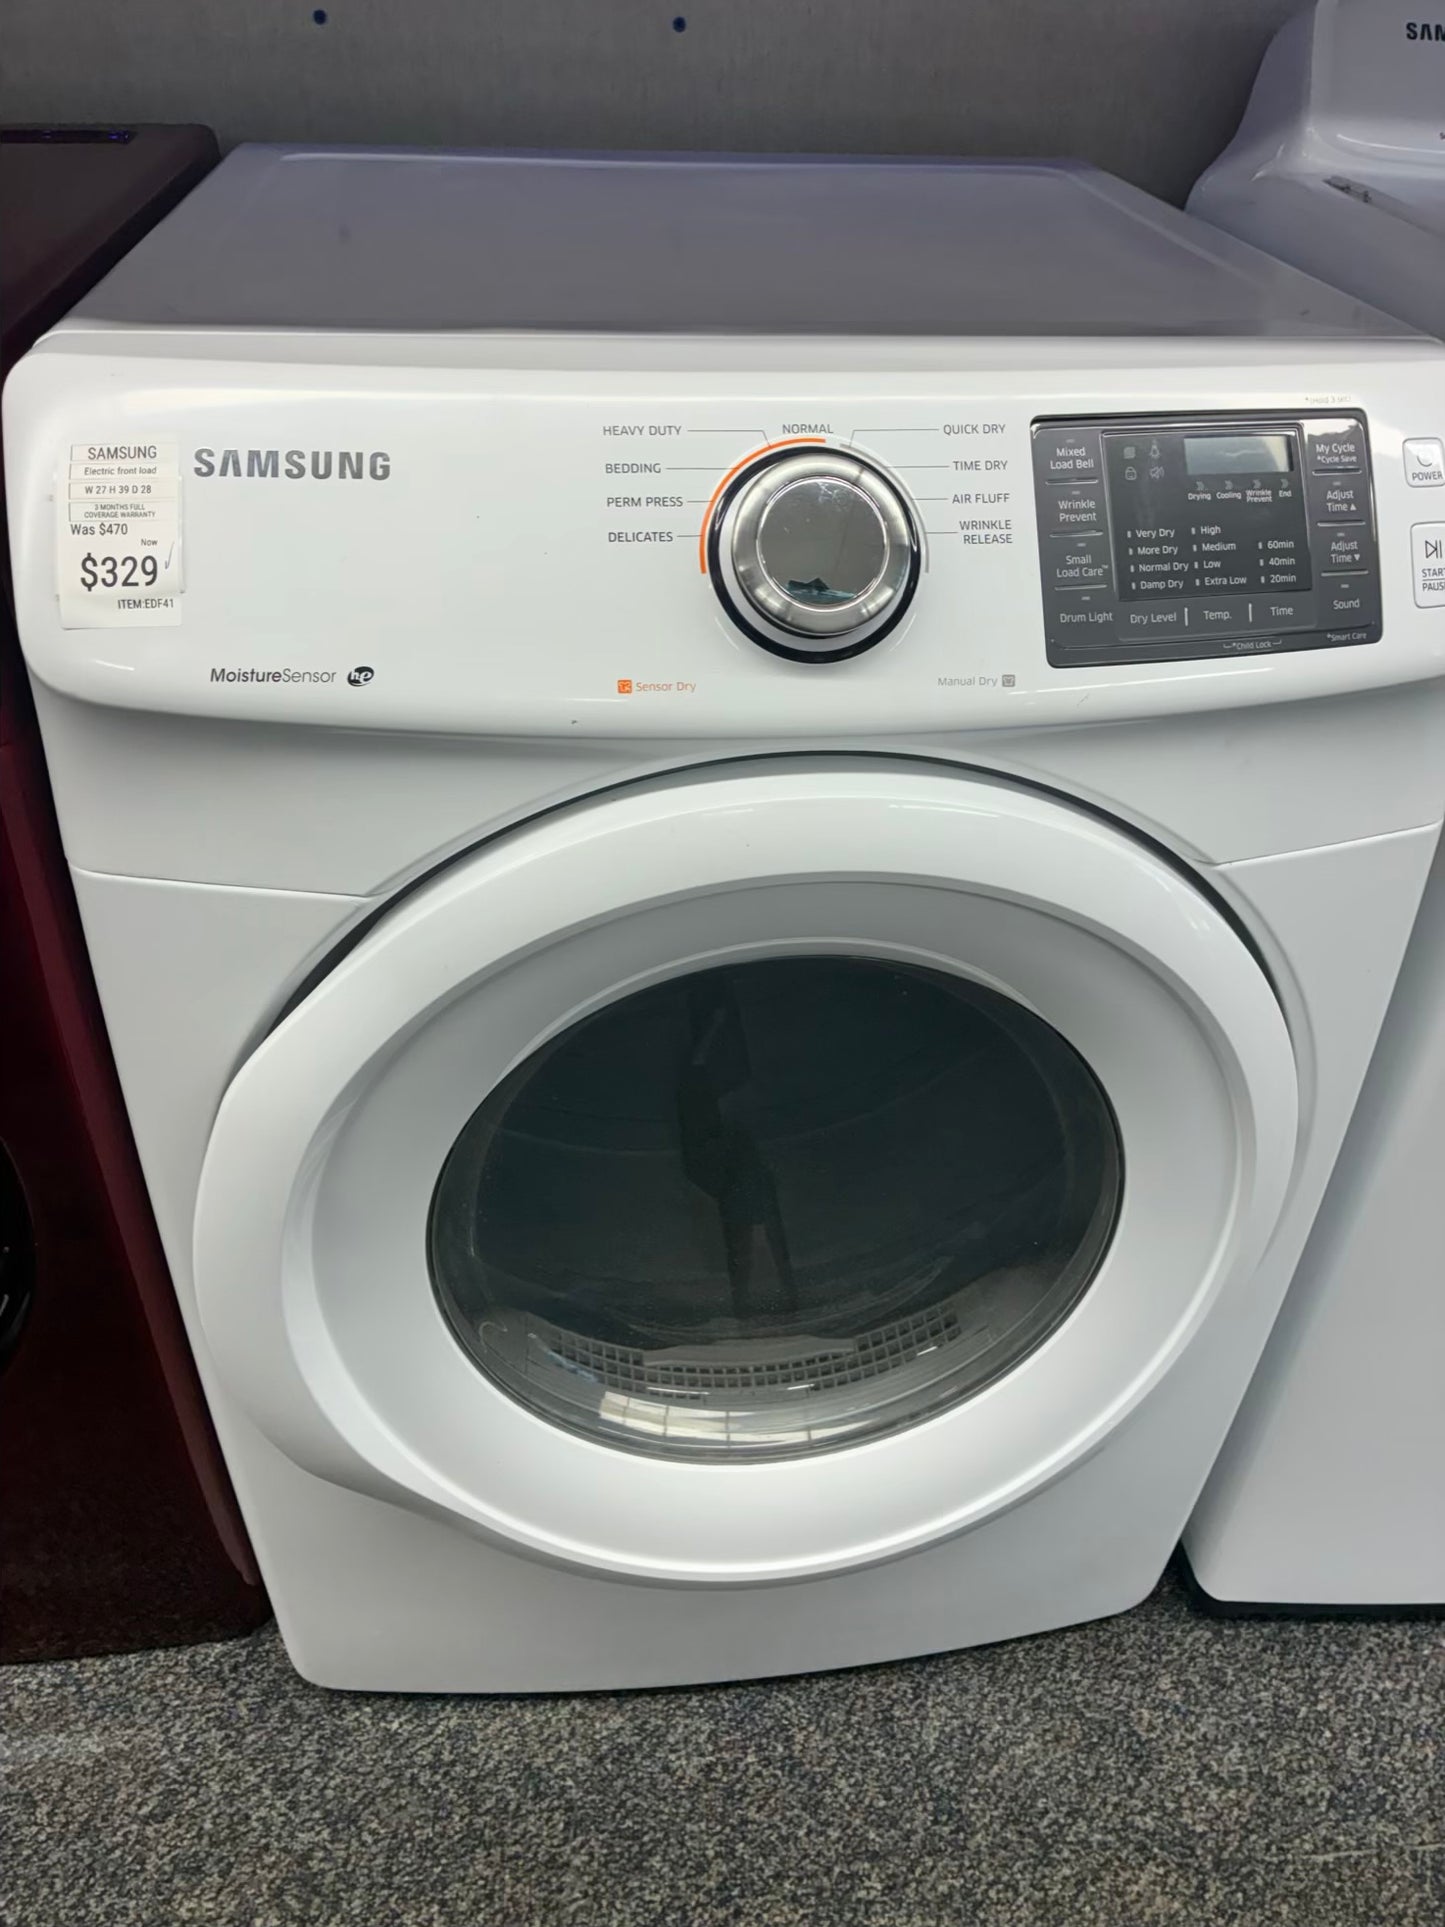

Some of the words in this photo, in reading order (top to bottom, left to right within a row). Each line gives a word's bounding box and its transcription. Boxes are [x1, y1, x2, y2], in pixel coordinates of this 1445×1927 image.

[603, 425, 644, 436] HEAVY
[649, 425, 682, 436] DUTY
[782, 424, 834, 434] NORMAL
[943, 424, 979, 435] QUICK
[983, 424, 1006, 434] DRY
[87, 446, 157, 460] SAMSUNG
[1056, 447, 1086, 456] Mixed
[1315, 444, 1329, 454] My
[1332, 443, 1355, 454] Cycle
[1340, 454, 1357, 463] Save
[194, 448, 390, 480] SAMSUNG
[605, 463, 662, 474] BEDDING
[953, 461, 981, 471] TIME
[985, 461, 1008, 471] DRY
[1050, 459, 1073, 470] Load
[1076, 458, 1094, 469] Bell
[84, 467, 114, 476] Electric
[117, 467, 136, 475] front
[139, 467, 157, 475] load
[1412, 471, 1443, 481] POWER
[85, 486, 93, 494] W
[96, 486, 106, 494] 27
[109, 486, 116, 494] H
[118, 486, 129, 494] 39
[132, 486, 138, 494] D
[141, 485, 151, 494] 28
[1246, 489, 1272, 497] Wrinkle
[952, 494, 971, 504] AIR
[975, 493, 1010, 504] FLUFF
[1188, 492, 1211, 501] Drying
[1216, 491, 1241, 500] Cooling
[1326, 490, 1354, 501] Adjust
[607, 497, 642, 508] PERM
[646, 497, 683, 508] PRESS
[1058, 500, 1096, 510] Wrinkle
[1327, 502, 1347, 512] Time
[84, 511, 119, 519] COVERAGE
[121, 511, 155, 519] WARRANTY
[1059, 512, 1097, 522] Prevent
[71, 524, 95, 536] Was
[99, 524, 128, 536] $470
[959, 520, 1012, 531] WRINKLE
[1136, 530, 1156, 540] Very
[1160, 528, 1175, 539] Dry
[1201, 526, 1221, 536] High
[608, 532, 673, 543] DELICATES
[964, 534, 1013, 545] RELEASE
[141, 539, 158, 547] Now
[1202, 542, 1236, 551] Medium
[1267, 540, 1294, 549] 60min
[1331, 542, 1358, 552] Adjust
[1138, 546, 1160, 555] More
[1163, 545, 1178, 555] Dry
[1066, 554, 1092, 564] Small
[1269, 557, 1295, 566] 40min
[1331, 554, 1352, 563] Time
[1139, 563, 1171, 573] Normal
[1173, 562, 1189, 572] Dry
[1204, 560, 1221, 568] Low
[81, 552, 158, 592] $329
[1057, 567, 1080, 577] Load
[1205, 577, 1227, 585] Extra
[1230, 575, 1247, 584] Low
[1270, 574, 1296, 583] 20min
[1141, 581, 1166, 591] Damp
[1168, 579, 1184, 590] Dry
[118, 599, 174, 610] ITEM:EDF41
[1333, 600, 1360, 609] Sound
[1204, 610, 1232, 621] Temp.
[1271, 607, 1294, 616] Time
[1060, 613, 1086, 623] Drum
[1089, 611, 1113, 623] Light
[1130, 614, 1148, 625] Dry
[1151, 612, 1176, 622] Level
[1352, 632, 1367, 640] Care
[1256, 641, 1272, 649] Lock
[210, 668, 336, 683] MoistureSensor
[938, 675, 975, 686] Manual
[979, 675, 998, 687] Dry
[636, 682, 672, 692] Sensor
[677, 681, 696, 693] Dry
